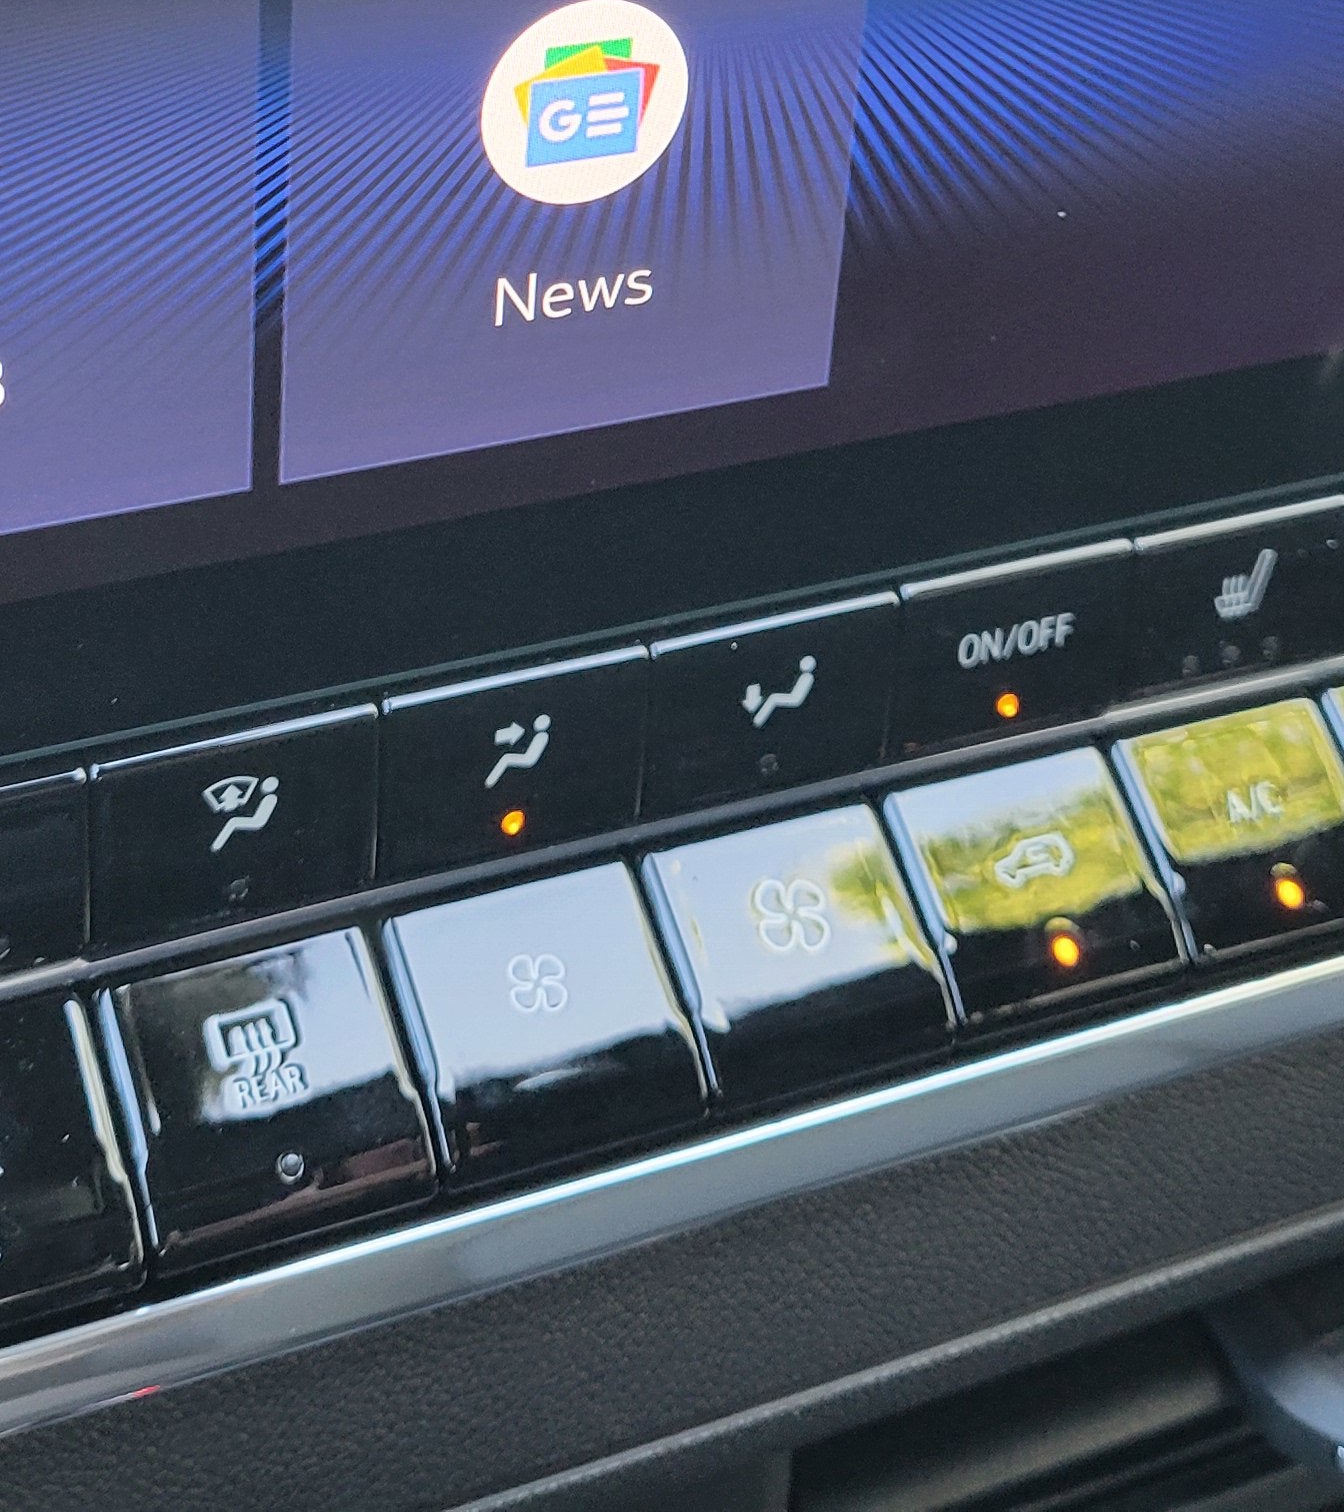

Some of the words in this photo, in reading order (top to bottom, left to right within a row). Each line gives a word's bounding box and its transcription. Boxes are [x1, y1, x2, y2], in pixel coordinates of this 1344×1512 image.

[493, 269, 654, 327] News
[957, 612, 1076, 669] ON/OFF
[1226, 780, 1283, 824] A/C
[231, 1062, 310, 1110] REAR
